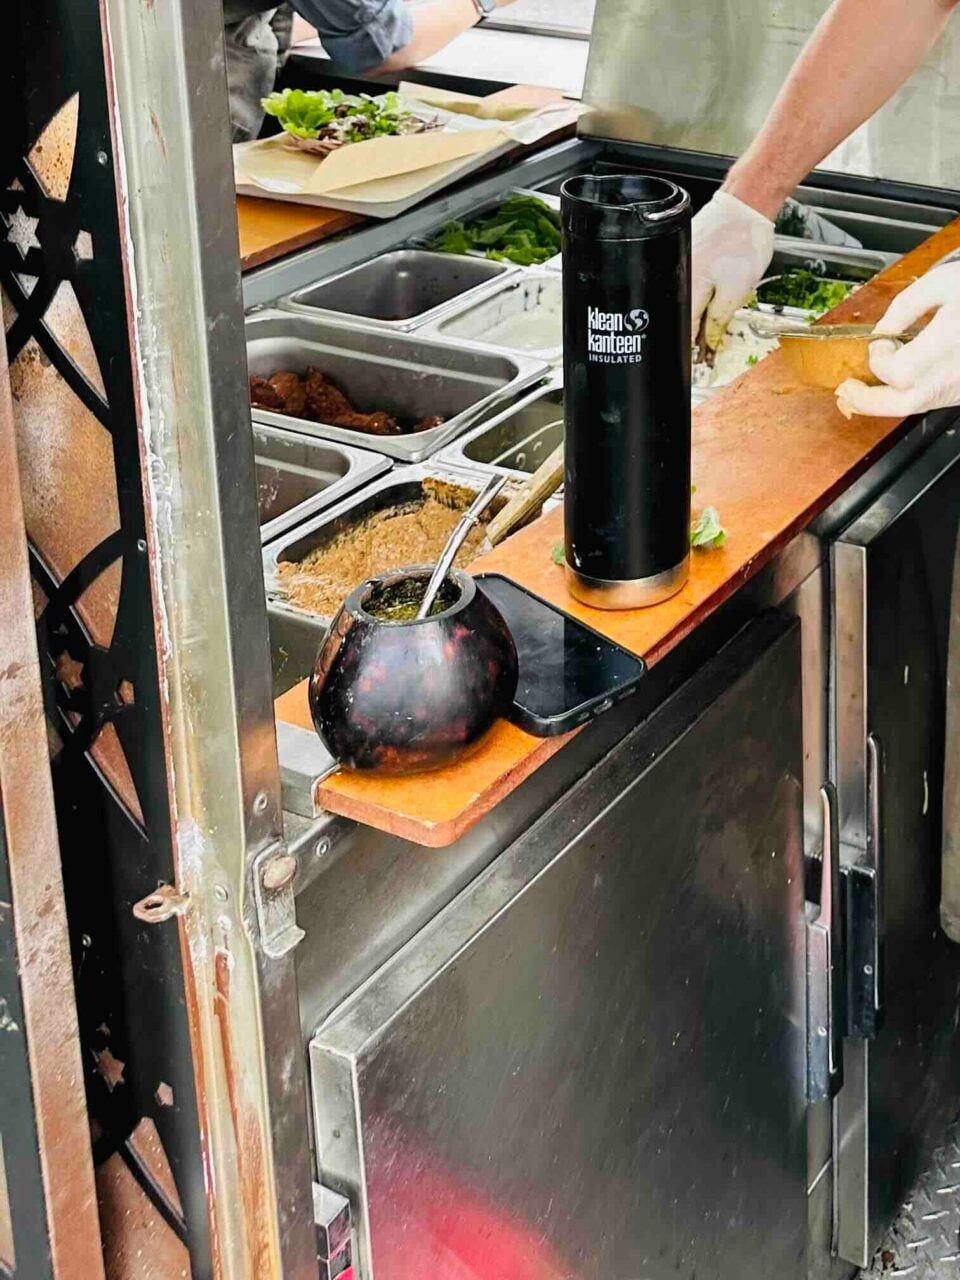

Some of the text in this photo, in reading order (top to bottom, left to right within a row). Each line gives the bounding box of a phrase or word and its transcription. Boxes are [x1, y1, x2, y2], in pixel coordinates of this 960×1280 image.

[587, 305, 623, 332] klean
[587, 328, 642, 354] kanteen
[588, 352, 642, 364] INSULATED
